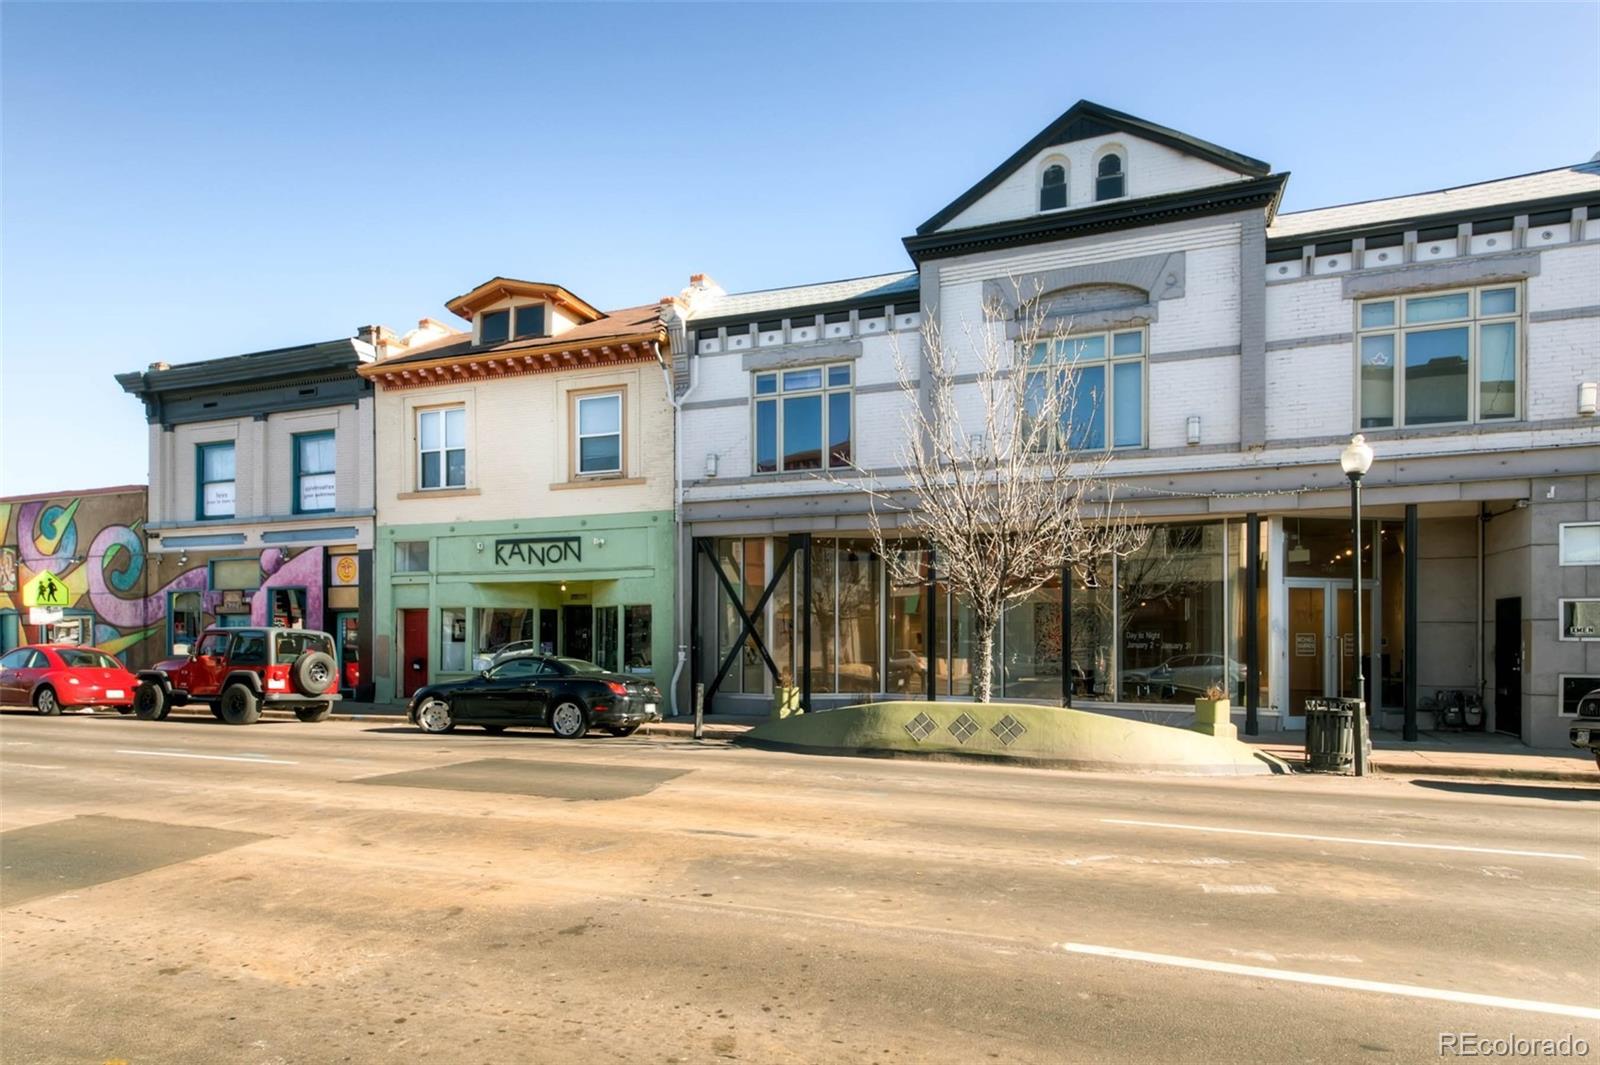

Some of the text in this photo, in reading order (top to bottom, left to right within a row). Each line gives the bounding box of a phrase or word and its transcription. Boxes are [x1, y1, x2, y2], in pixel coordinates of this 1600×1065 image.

[495, 536, 581, 566] KANON
[1126, 631, 1137, 640] Day
[1145, 631, 1160, 640] Night
[1126, 641, 1148, 650] January
[1160, 641, 1183, 651] January
